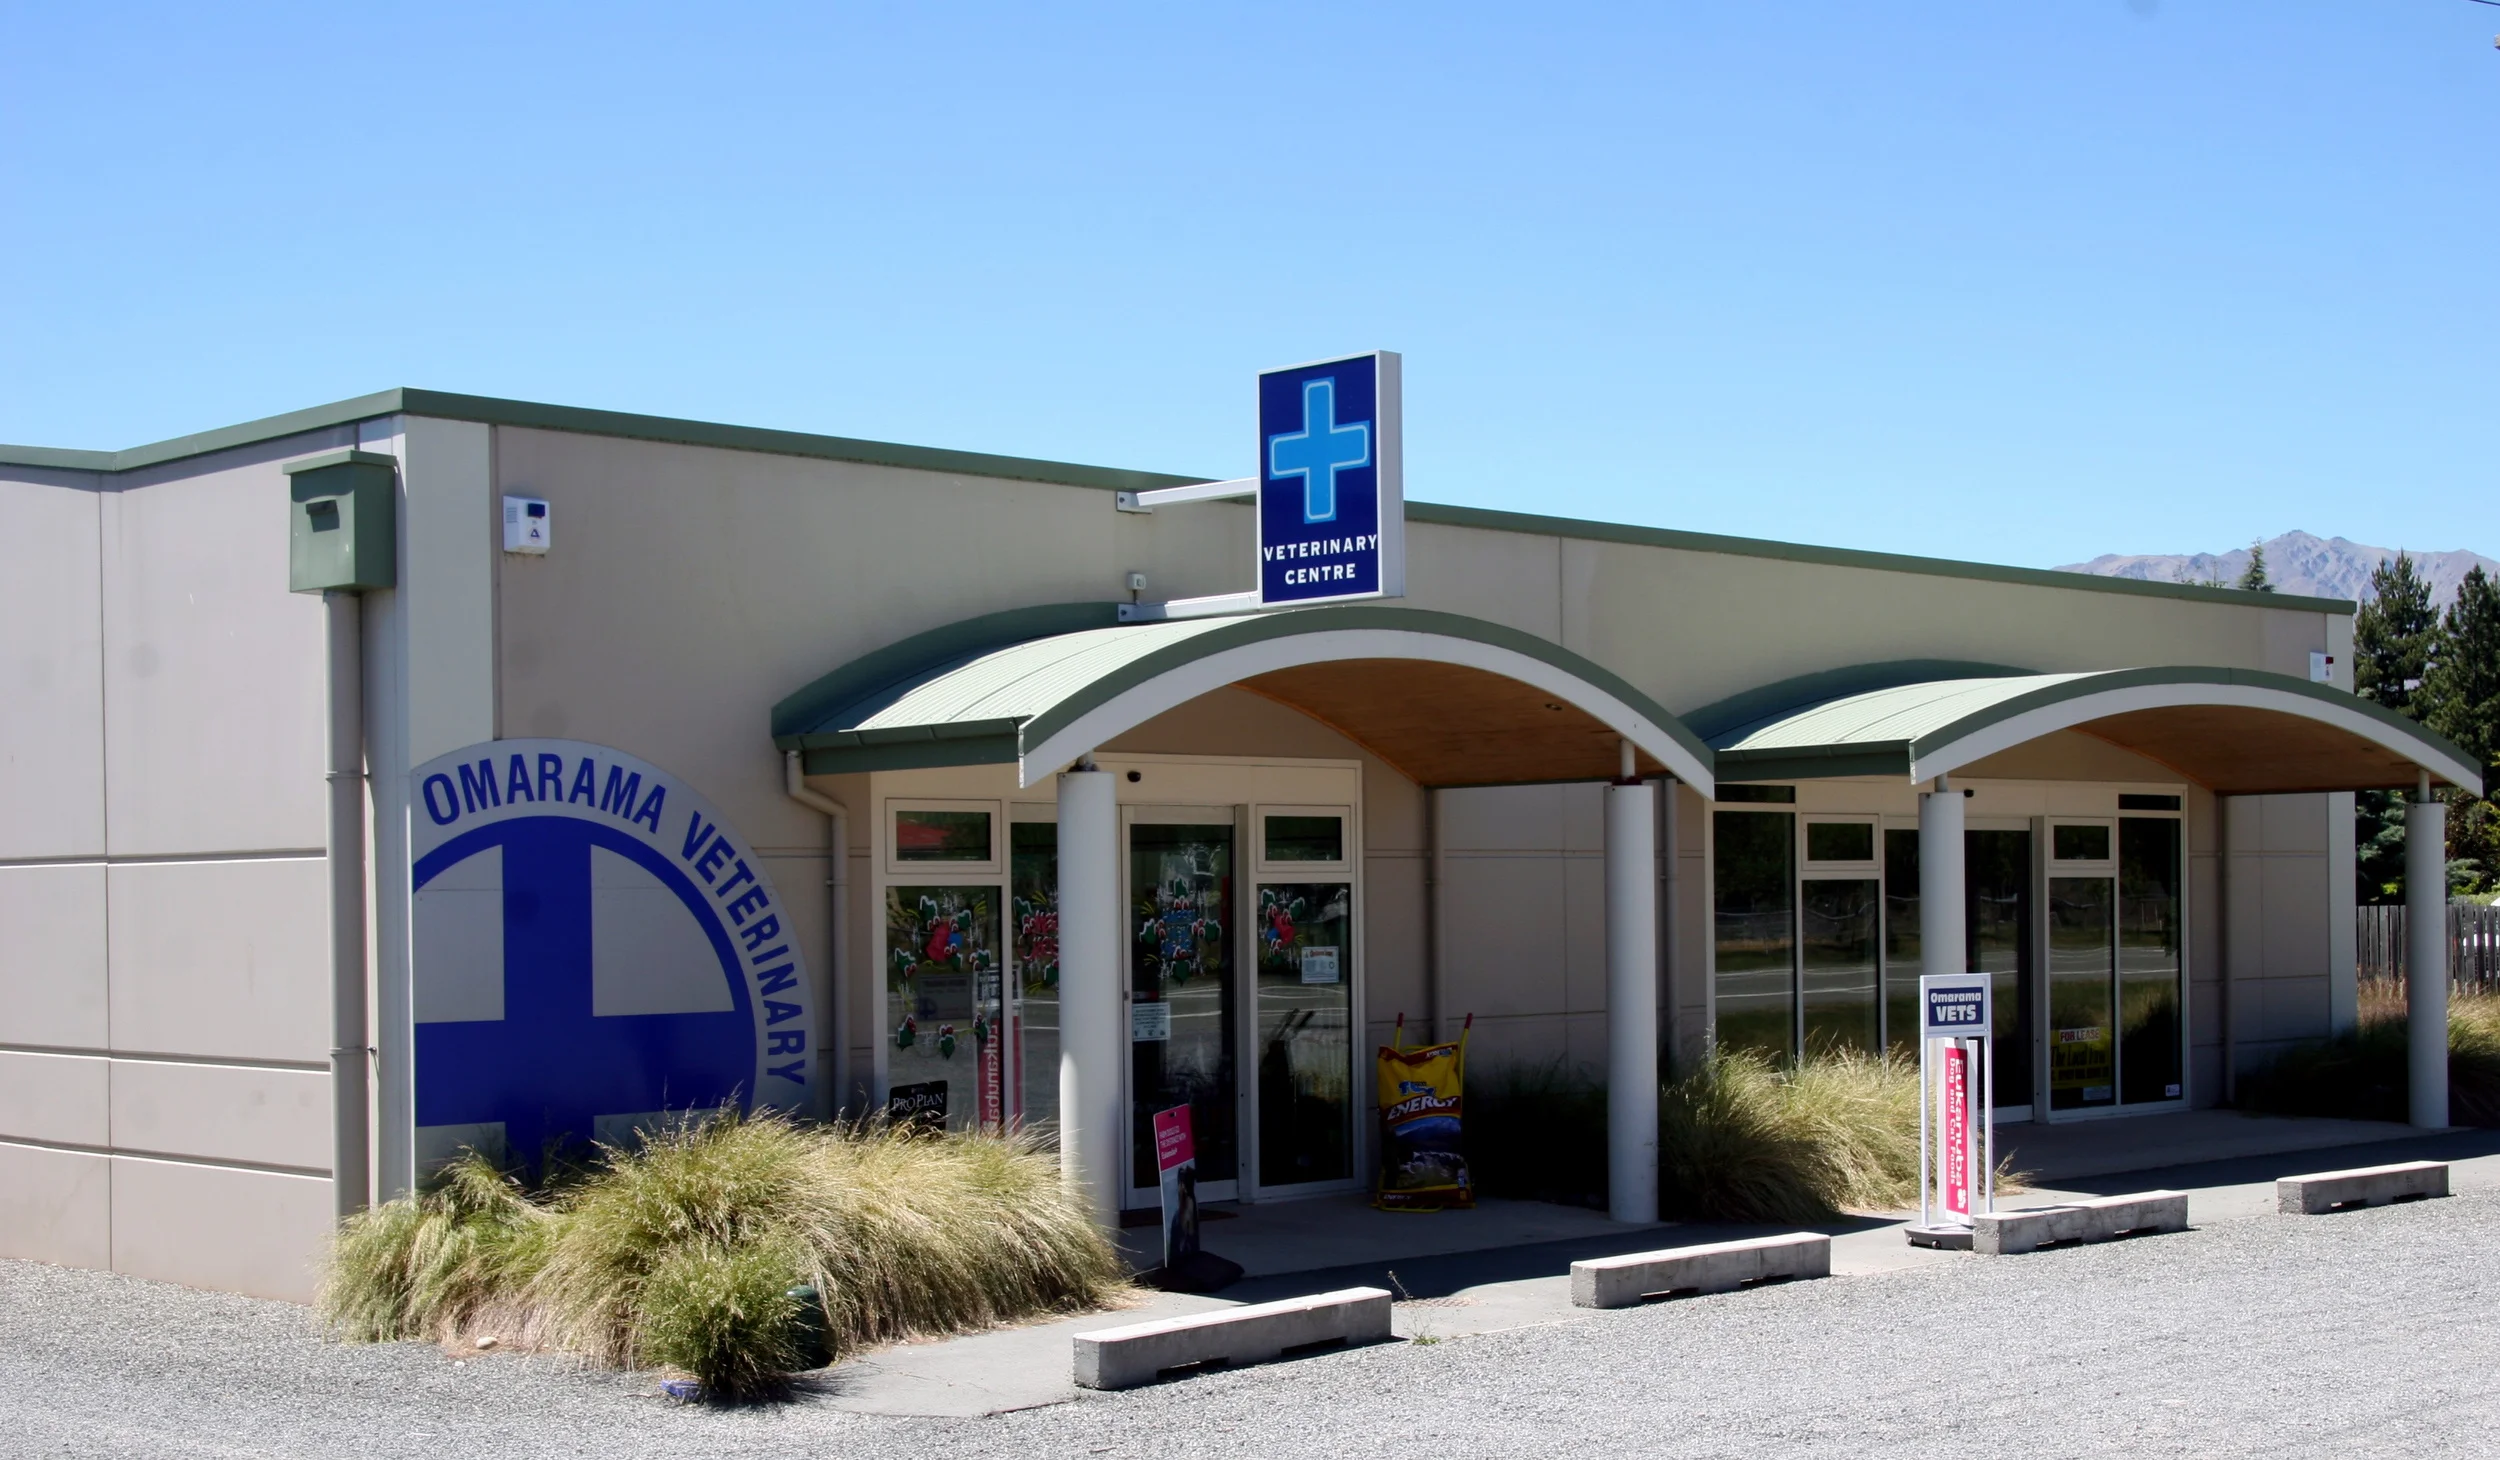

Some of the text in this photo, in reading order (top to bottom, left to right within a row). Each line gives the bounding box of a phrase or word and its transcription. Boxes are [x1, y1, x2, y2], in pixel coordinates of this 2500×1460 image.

[1263, 534, 1377, 561] VETERINARY
[1284, 563, 1356, 585] CENTRE
[422, 753, 806, 1085] OMARAMA VETERINARY
[1930, 992, 1982, 1003] Omarama
[1936, 1004, 1977, 1022] VETS
[2060, 1029, 2100, 1042] FOR LEASE
[1955, 1058, 1964, 1187] Eukanuba
